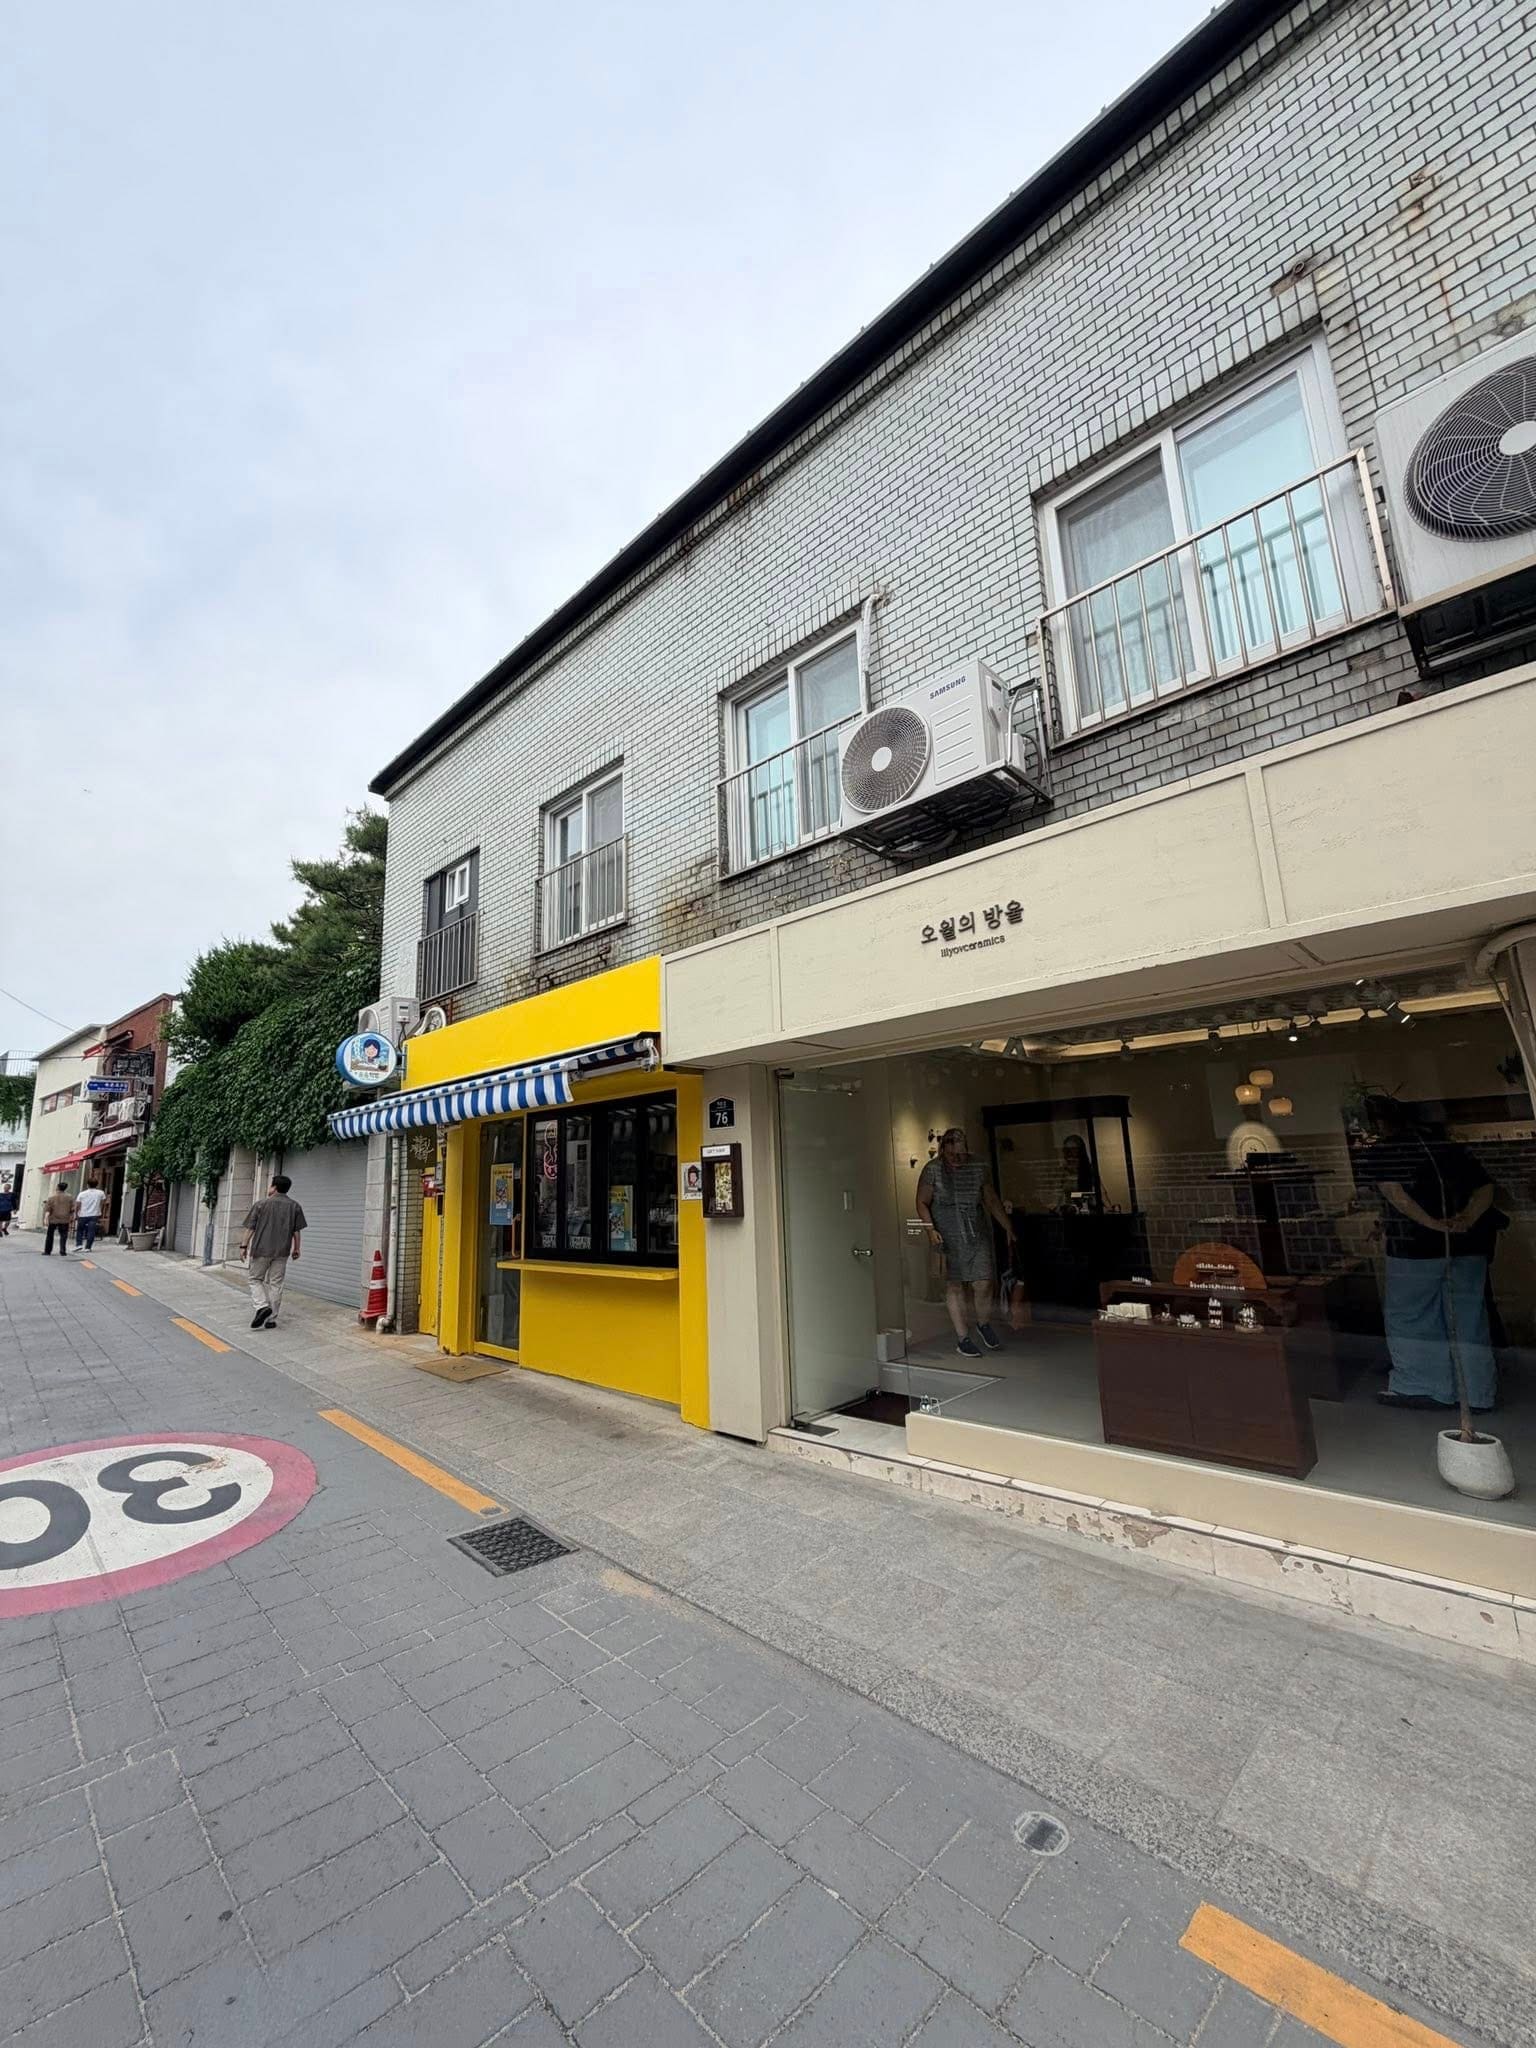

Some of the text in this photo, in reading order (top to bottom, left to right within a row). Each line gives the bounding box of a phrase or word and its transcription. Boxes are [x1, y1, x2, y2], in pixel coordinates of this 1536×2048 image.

[929, 675, 966, 699] SAMSUNG
[920, 899, 1024, 945] 오월의 방울
[716, 1112, 728, 1125] 76
[0, 1450, 242, 1570] 30
